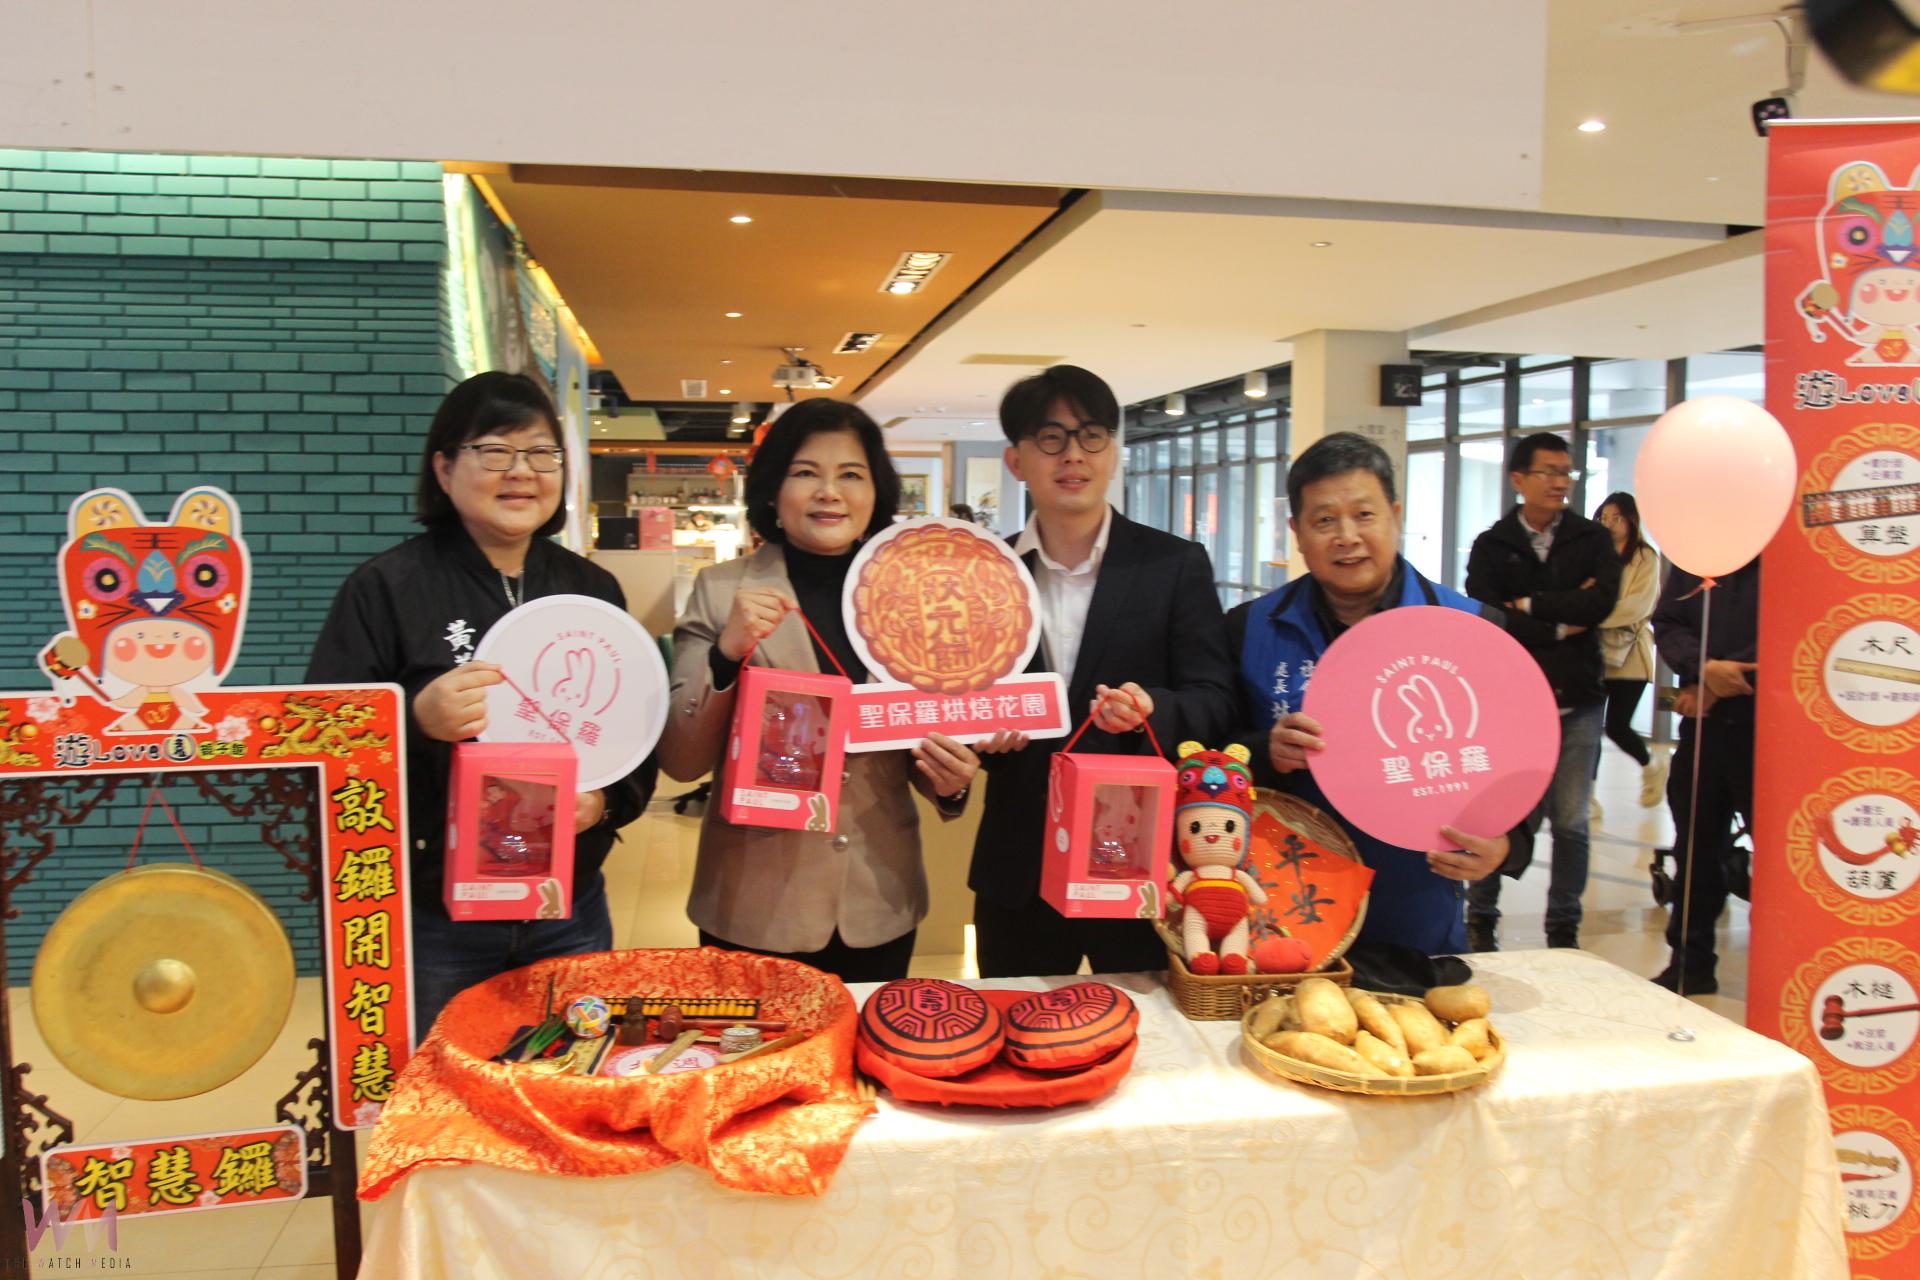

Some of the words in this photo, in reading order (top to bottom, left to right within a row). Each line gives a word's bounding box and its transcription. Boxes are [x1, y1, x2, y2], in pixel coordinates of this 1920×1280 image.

[1856, 525, 1910, 546] 算盤
[1859, 635, 1914, 656] 木尺
[1375, 655, 1417, 684] SAINT
[1420, 654, 1460, 675] PAUL
[858, 693, 1047, 729] 聖保羅烘焙花園
[1380, 745, 1492, 785] 聖保羅
[1412, 780, 1470, 798] EST.1991
[331, 778, 398, 1102] 敲鑼開智慧
[73, 1141, 279, 1211] 智慧鑼
